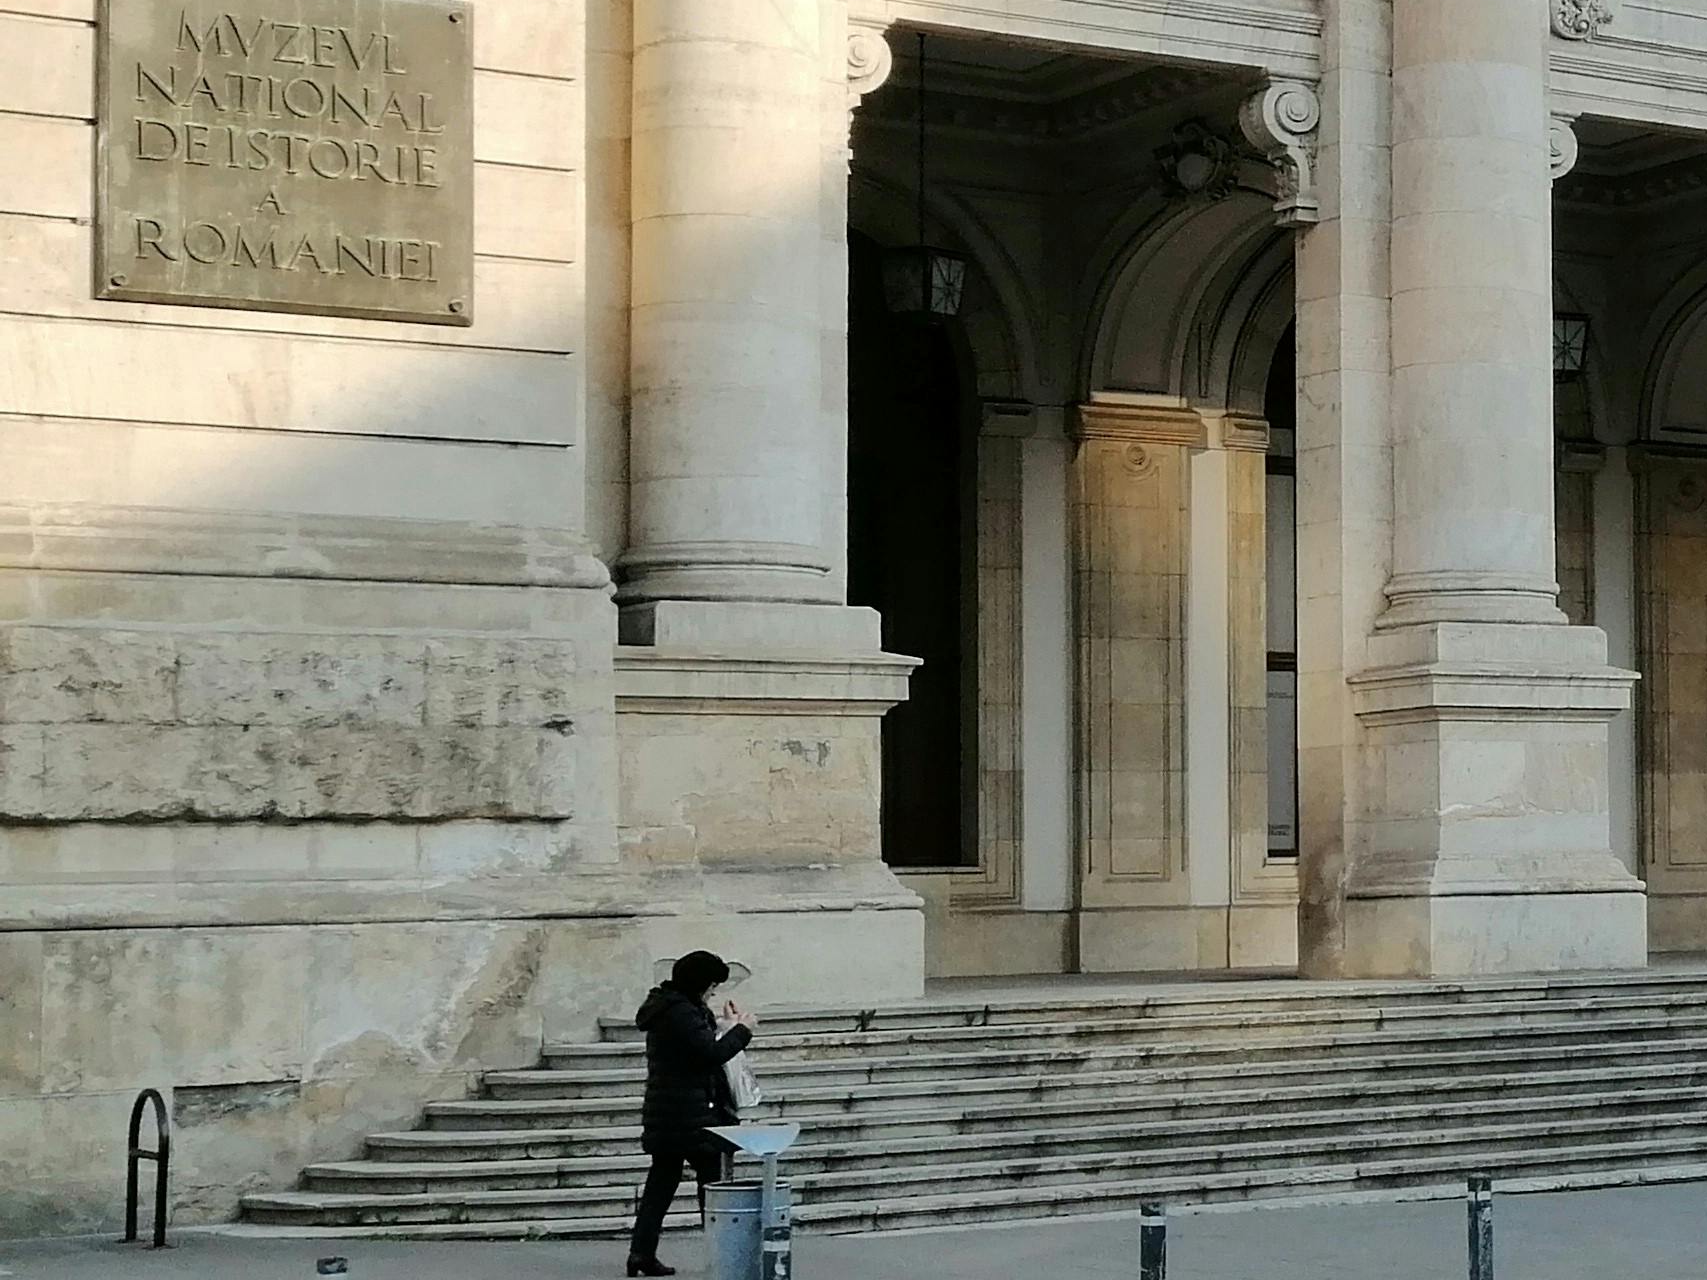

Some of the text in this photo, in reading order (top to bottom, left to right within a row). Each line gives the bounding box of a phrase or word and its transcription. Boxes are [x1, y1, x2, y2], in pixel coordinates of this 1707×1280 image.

[174, 8, 408, 76] MVZEVL
[134, 61, 445, 137] NATIONAL
[256, 184, 288, 215] A
[134, 217, 443, 283] ROMANIEI
